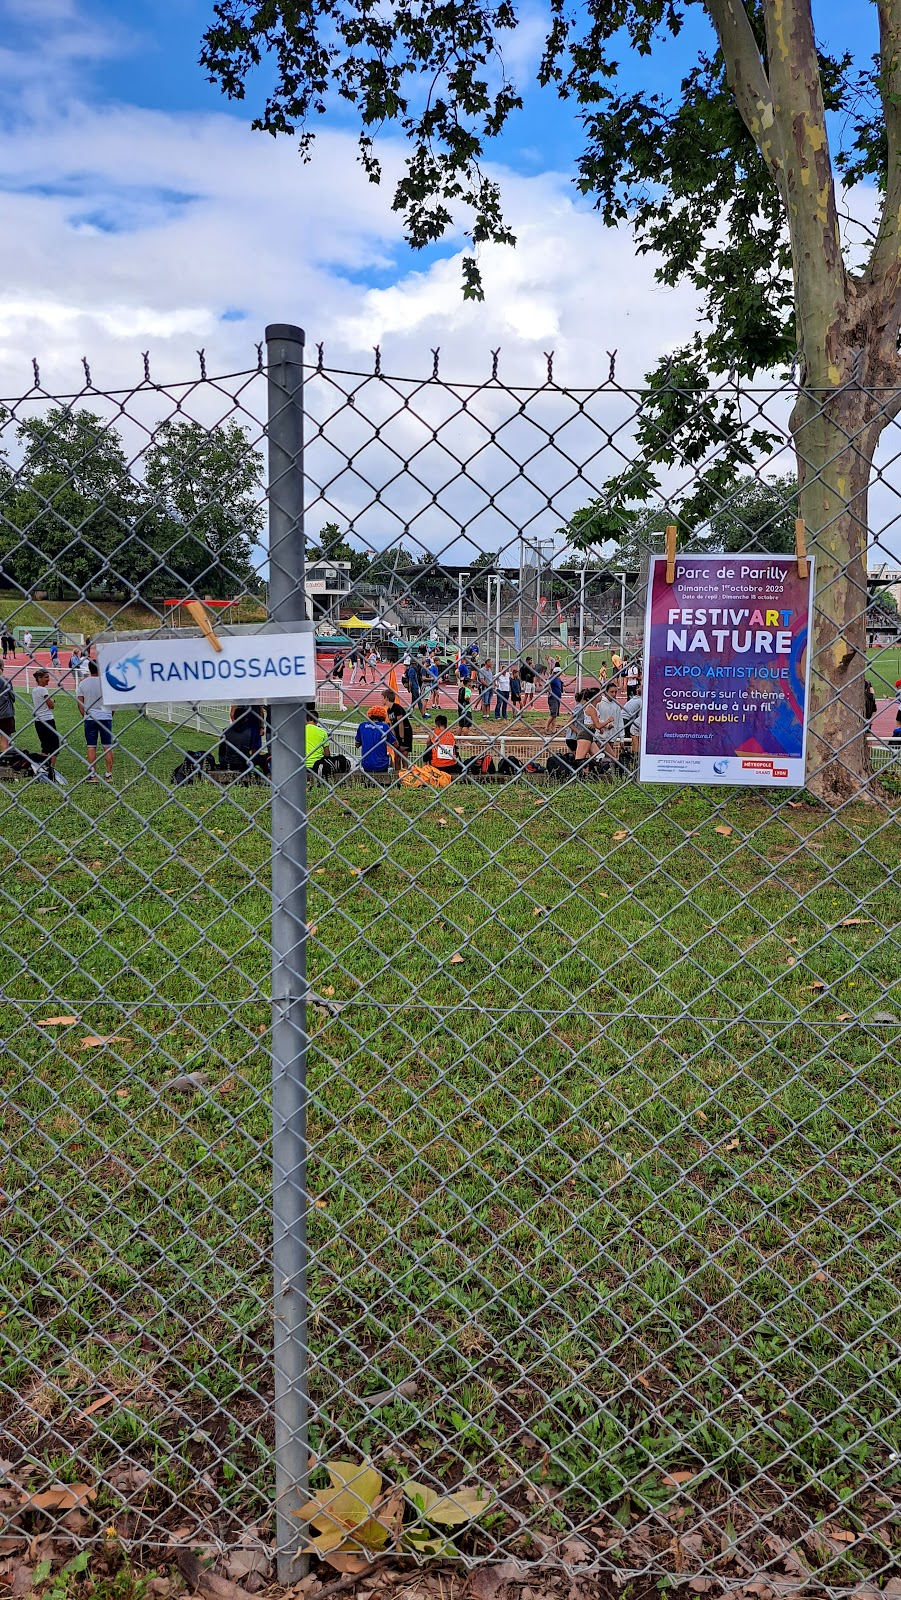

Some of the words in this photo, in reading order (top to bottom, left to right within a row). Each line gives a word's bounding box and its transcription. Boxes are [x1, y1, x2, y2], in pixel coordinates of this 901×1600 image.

[676, 566, 710, 580] Parc
[716, 566, 735, 579] de
[740, 566, 788, 582] Parilly
[668, 608, 793, 627] FESTIV'ART
[666, 630, 792, 654] NATURE
[150, 656, 306, 682] RANDOSSAGE
[664, 666, 702, 677] EXPO
[706, 666, 789, 679] ARTISTIQUE
[663, 688, 716, 698] Concours
[718, 690, 736, 698] sur
[738, 689, 749, 699] le
[750, 690, 785, 700] thème
[732, 700, 739, 711] à
[665, 713, 688, 722] Vote
[692, 713, 705, 722] du
[708, 713, 739, 724] public
